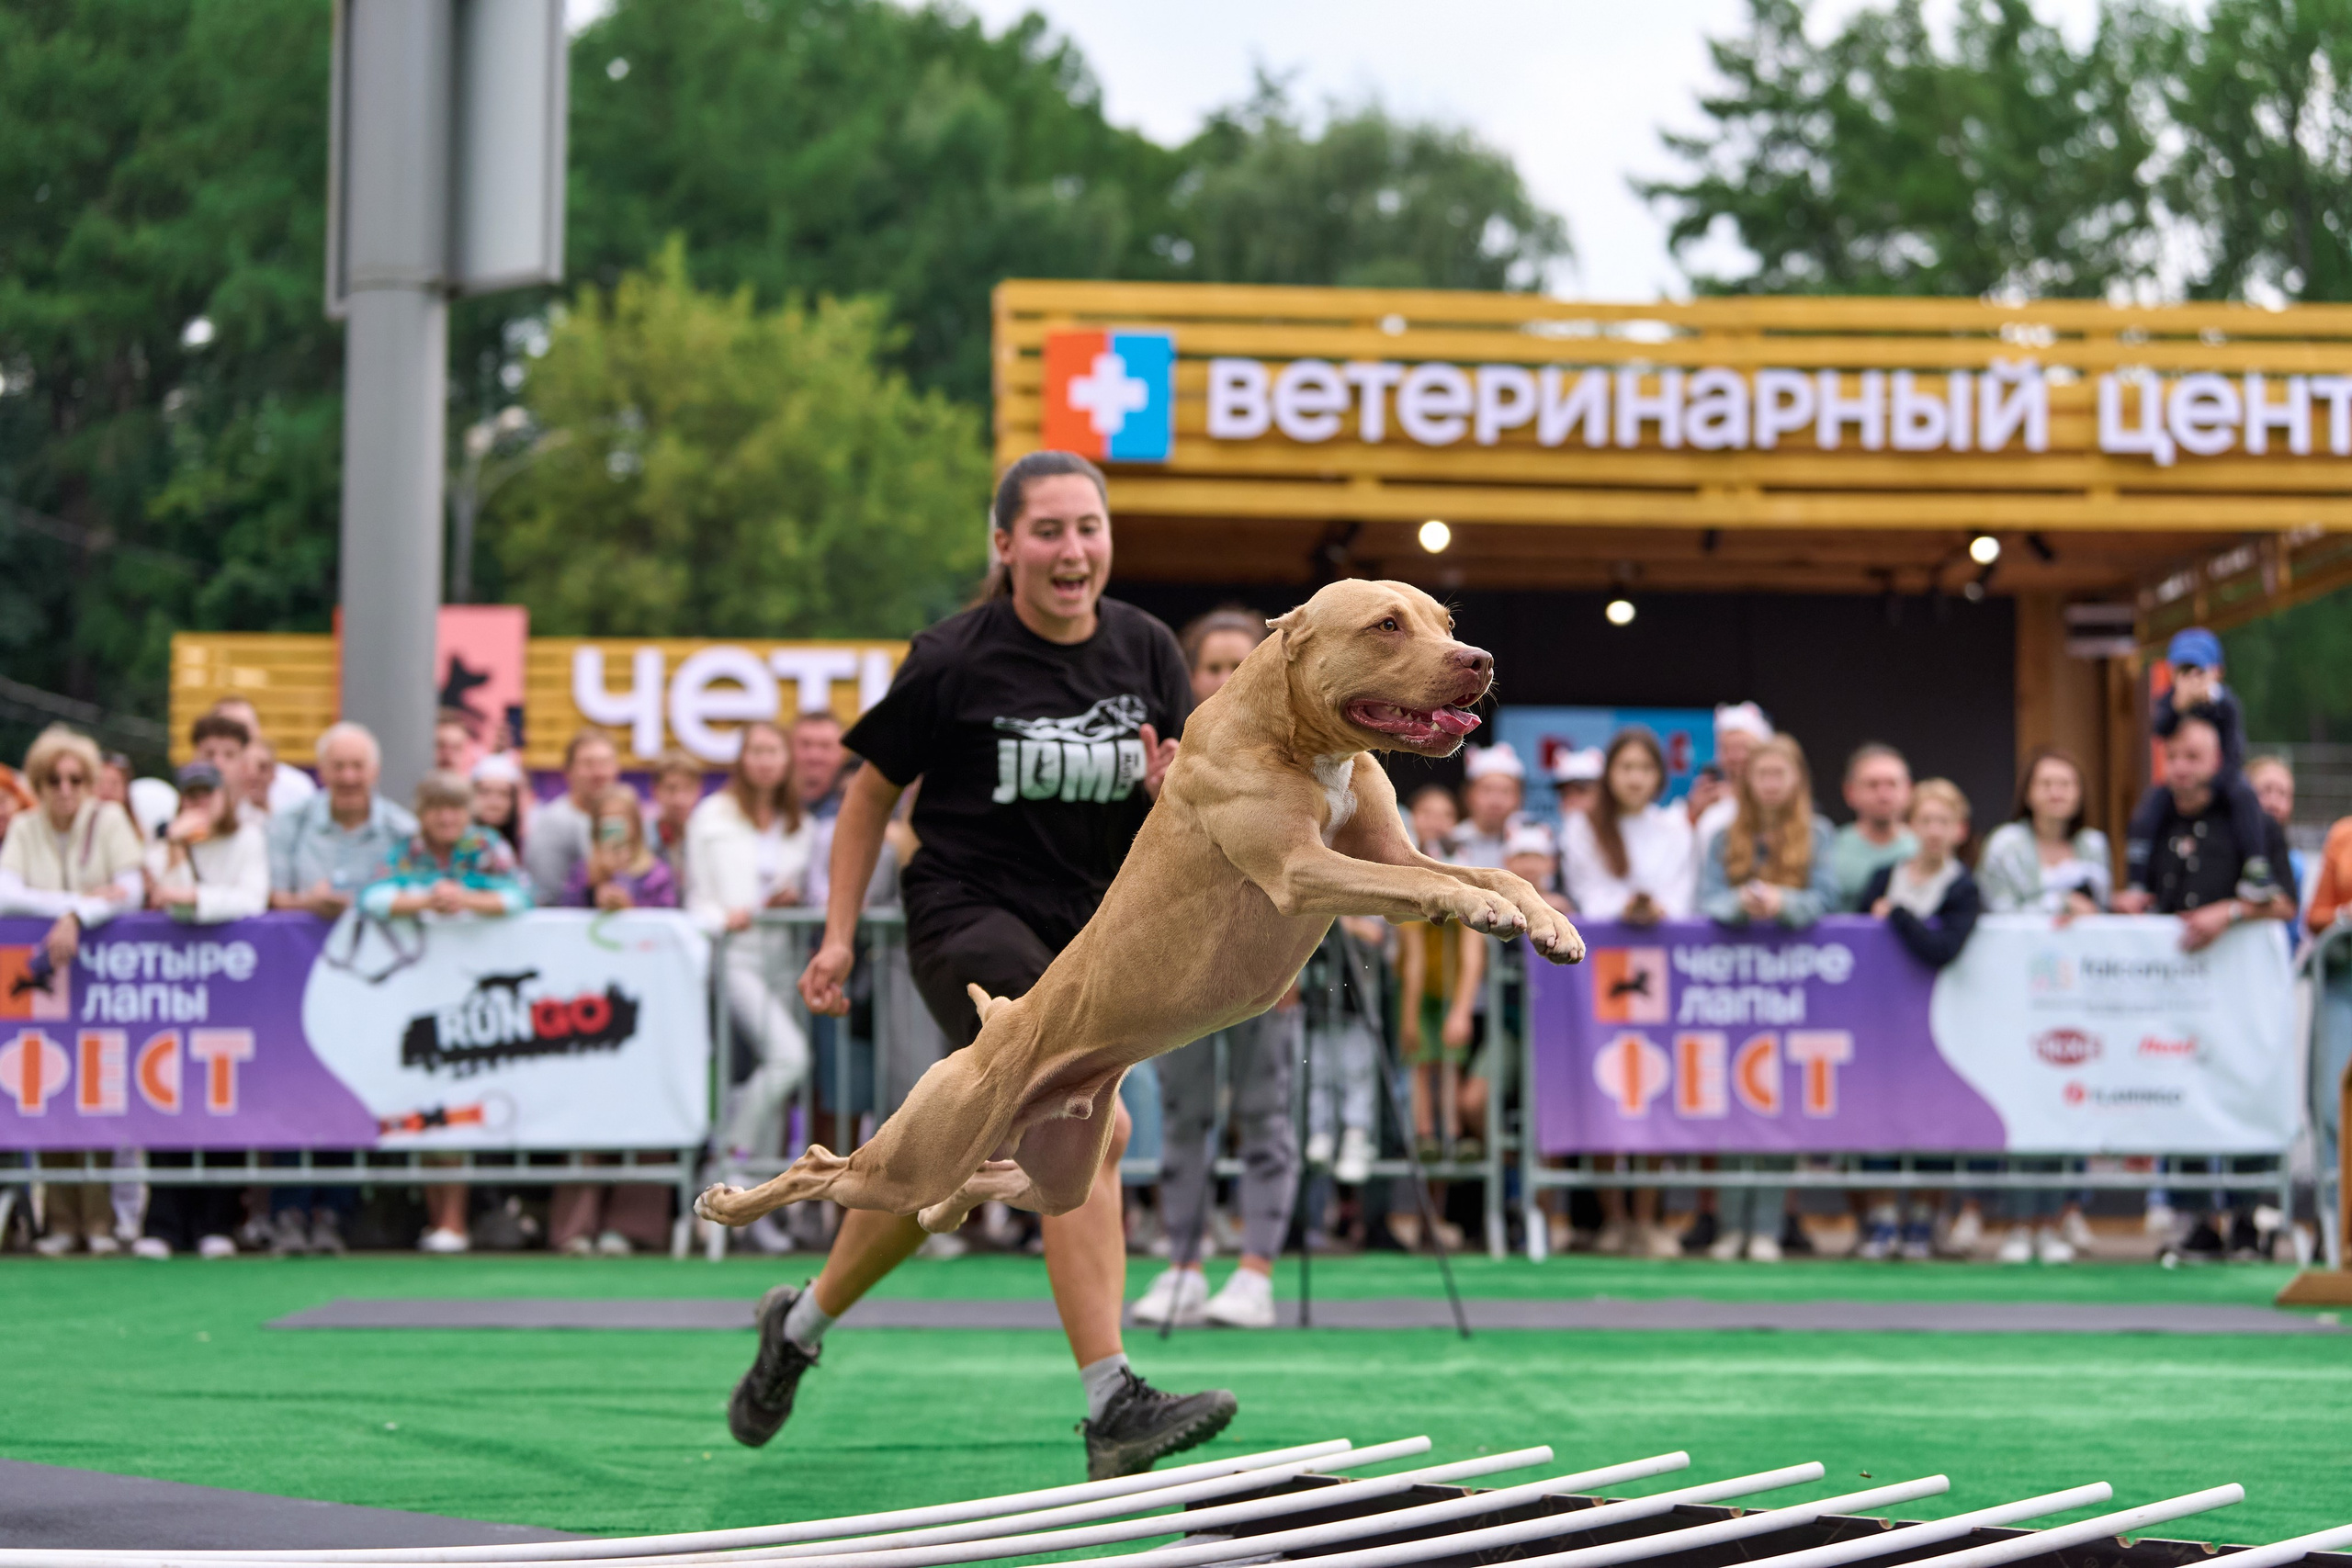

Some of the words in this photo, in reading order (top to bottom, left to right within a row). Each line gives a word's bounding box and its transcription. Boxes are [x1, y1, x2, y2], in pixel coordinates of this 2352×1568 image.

[1207, 355, 2048, 452] ветеринарный
[2098, 370, 2352, 466] цент
[572, 645, 893, 763] чет
[992, 739, 1147, 804] JUMP
[79, 940, 258, 982] четыре
[1672, 942, 1854, 984] четыре
[81, 982, 209, 1022] лапы
[1676, 985, 1807, 1025] лапы
[0, 1027, 256, 1117] ФЕСТ
[1592, 1029, 1856, 1121] ФЕСТ
